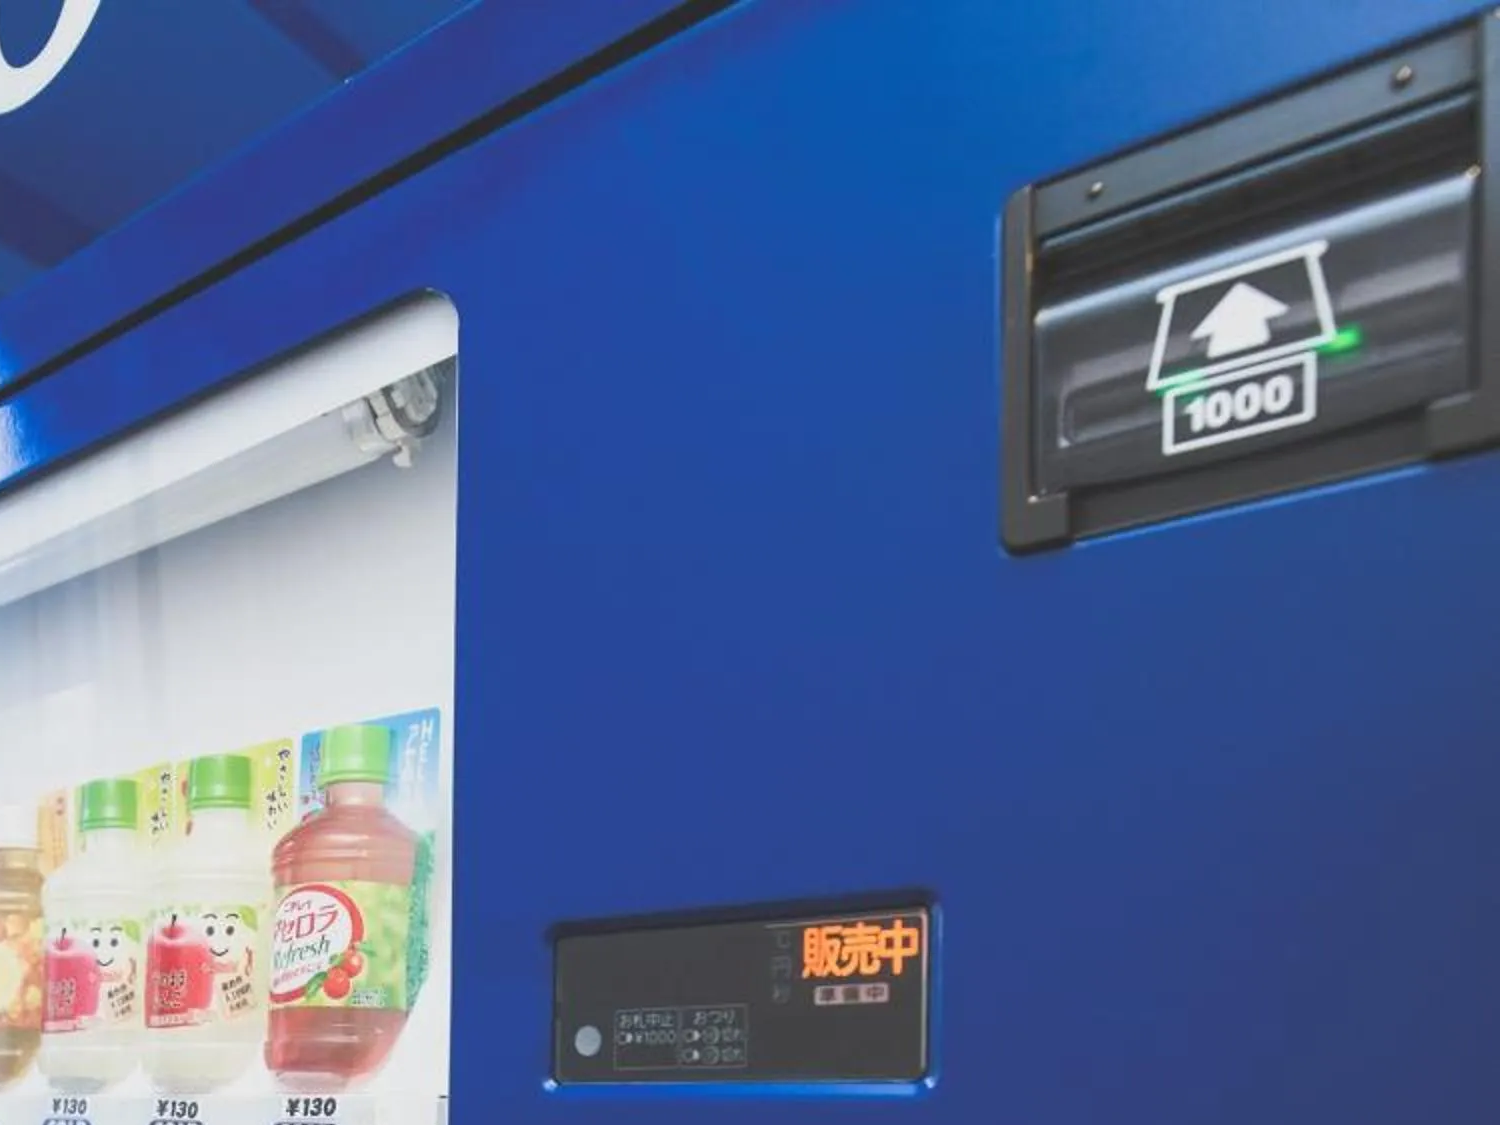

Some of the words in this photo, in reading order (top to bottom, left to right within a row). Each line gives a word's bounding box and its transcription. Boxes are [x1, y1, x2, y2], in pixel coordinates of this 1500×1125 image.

[1183, 373, 1295, 434] 1000
[802, 918, 919, 978] 販売中
[51, 1098, 87, 1116] ¥130
[156, 1099, 199, 1119] ¥130
[285, 1097, 337, 1117] ¥130
